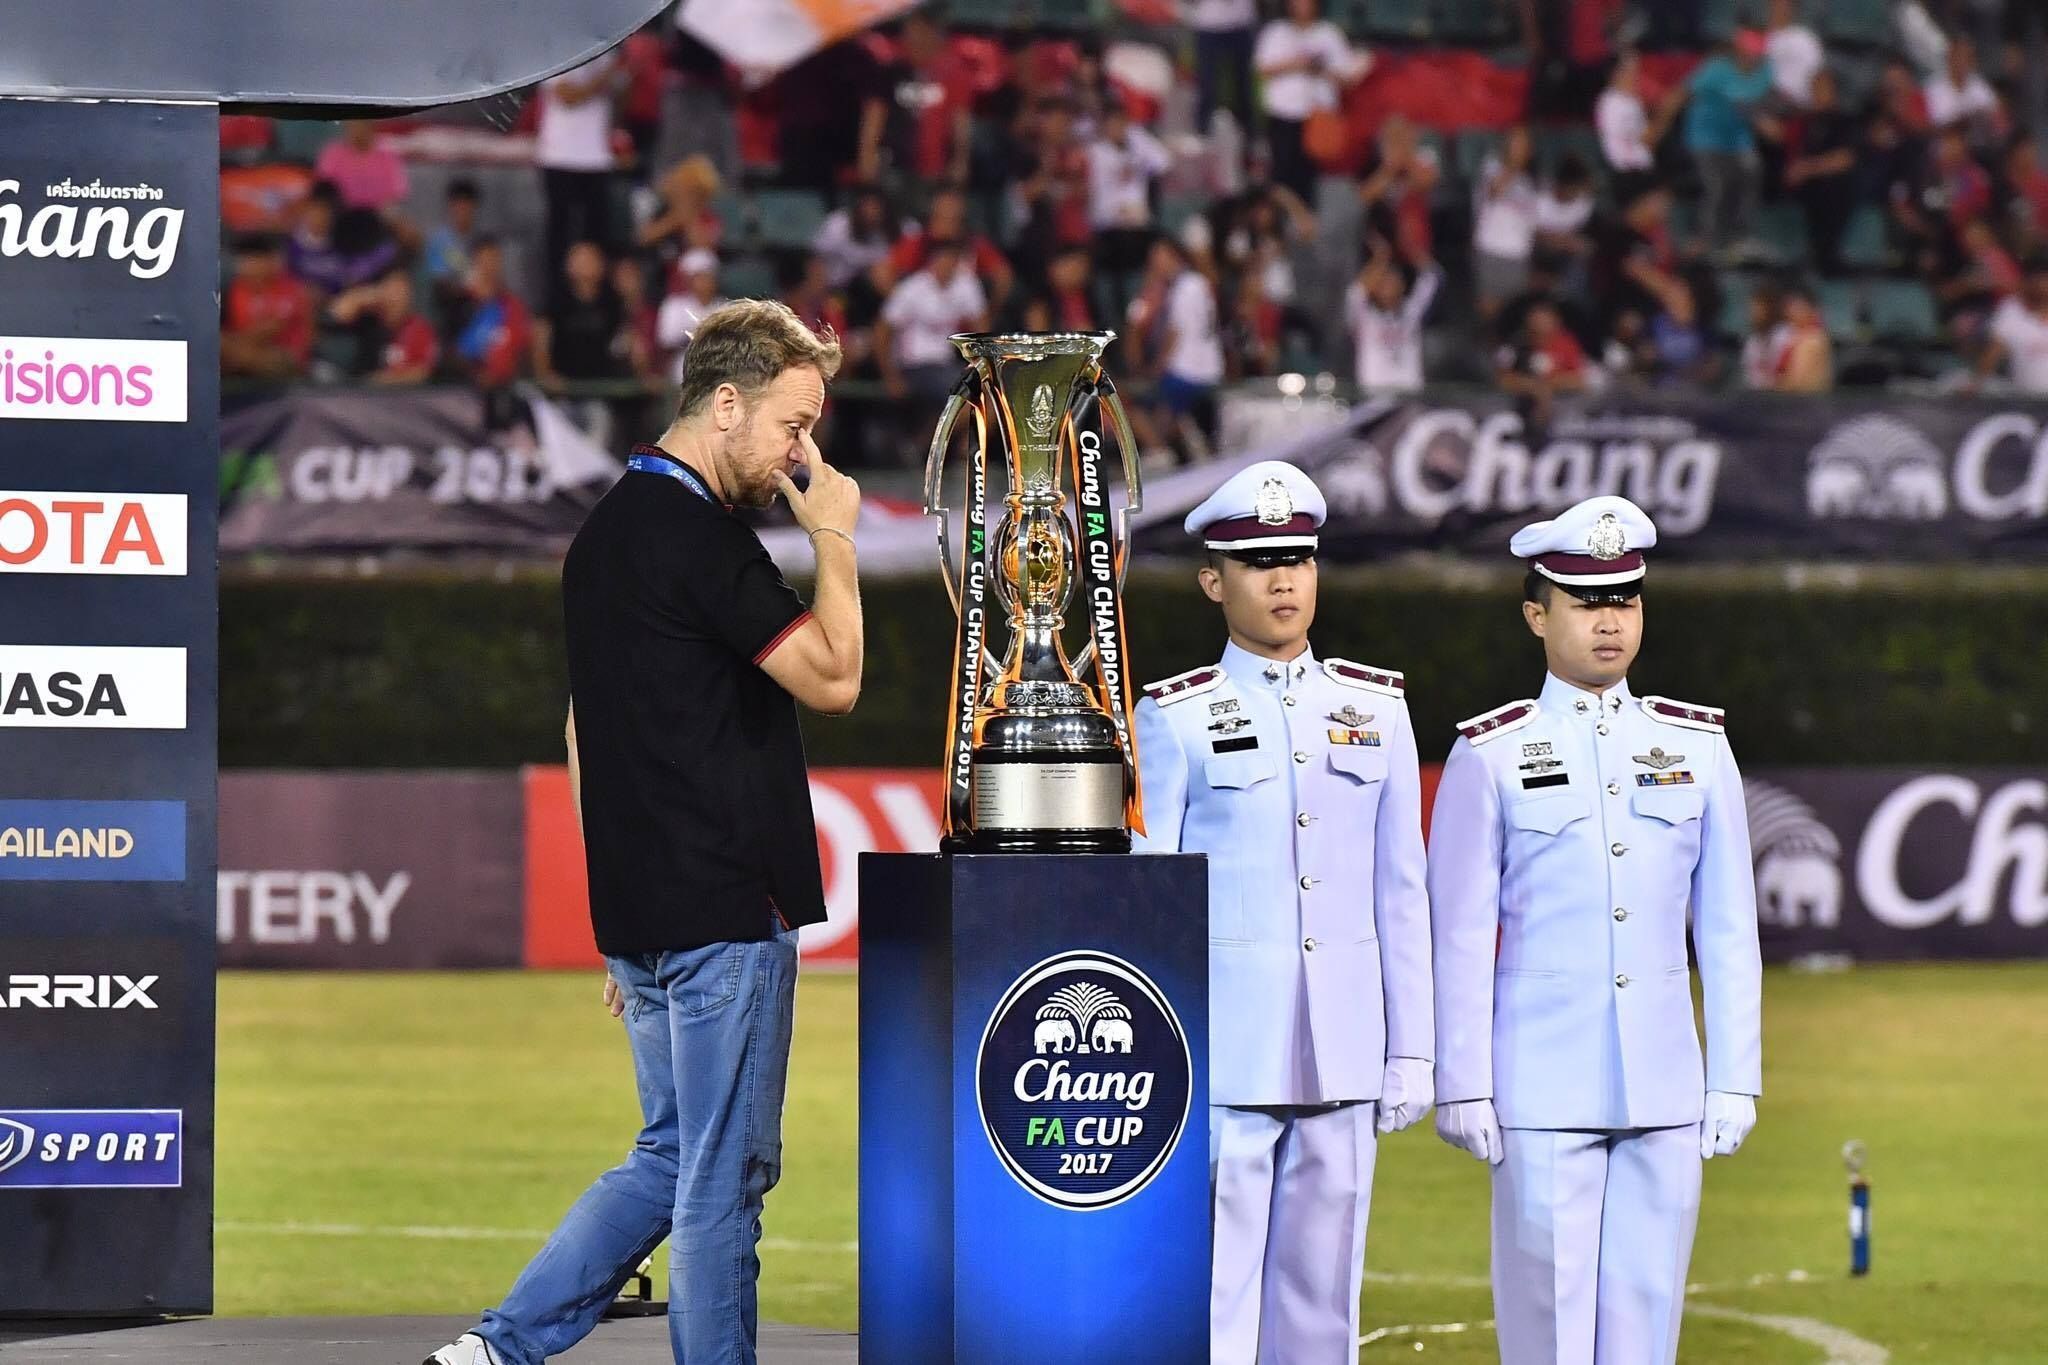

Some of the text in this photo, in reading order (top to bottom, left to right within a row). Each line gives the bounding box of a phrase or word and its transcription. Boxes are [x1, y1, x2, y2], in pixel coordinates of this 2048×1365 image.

[46, 177, 163, 200] เครื่องดื่มตราช้าง
[0, 349, 153, 406] isions
[291, 446, 415, 503] CUP
[1080, 430, 1101, 506] Chang
[1393, 409, 1721, 537] Chang
[972, 530, 984, 554] FA
[1087, 513, 1105, 536] FA
[970, 561, 985, 602] CUP
[1090, 540, 1111, 581] CUP
[962, 608, 983, 733] CHAMPIONS
[1094, 587, 1122, 712] CHAMPIONS
[0, 671, 127, 717] ASA
[956, 740, 972, 789] 2017
[0, 975, 159, 1008] RRIX
[1014, 1058, 1154, 1110] Chang
[40, 1132, 175, 1161] SPORT
[1026, 1117, 1143, 1145] FA CUP
[1058, 1153, 1112, 1174] 2017
